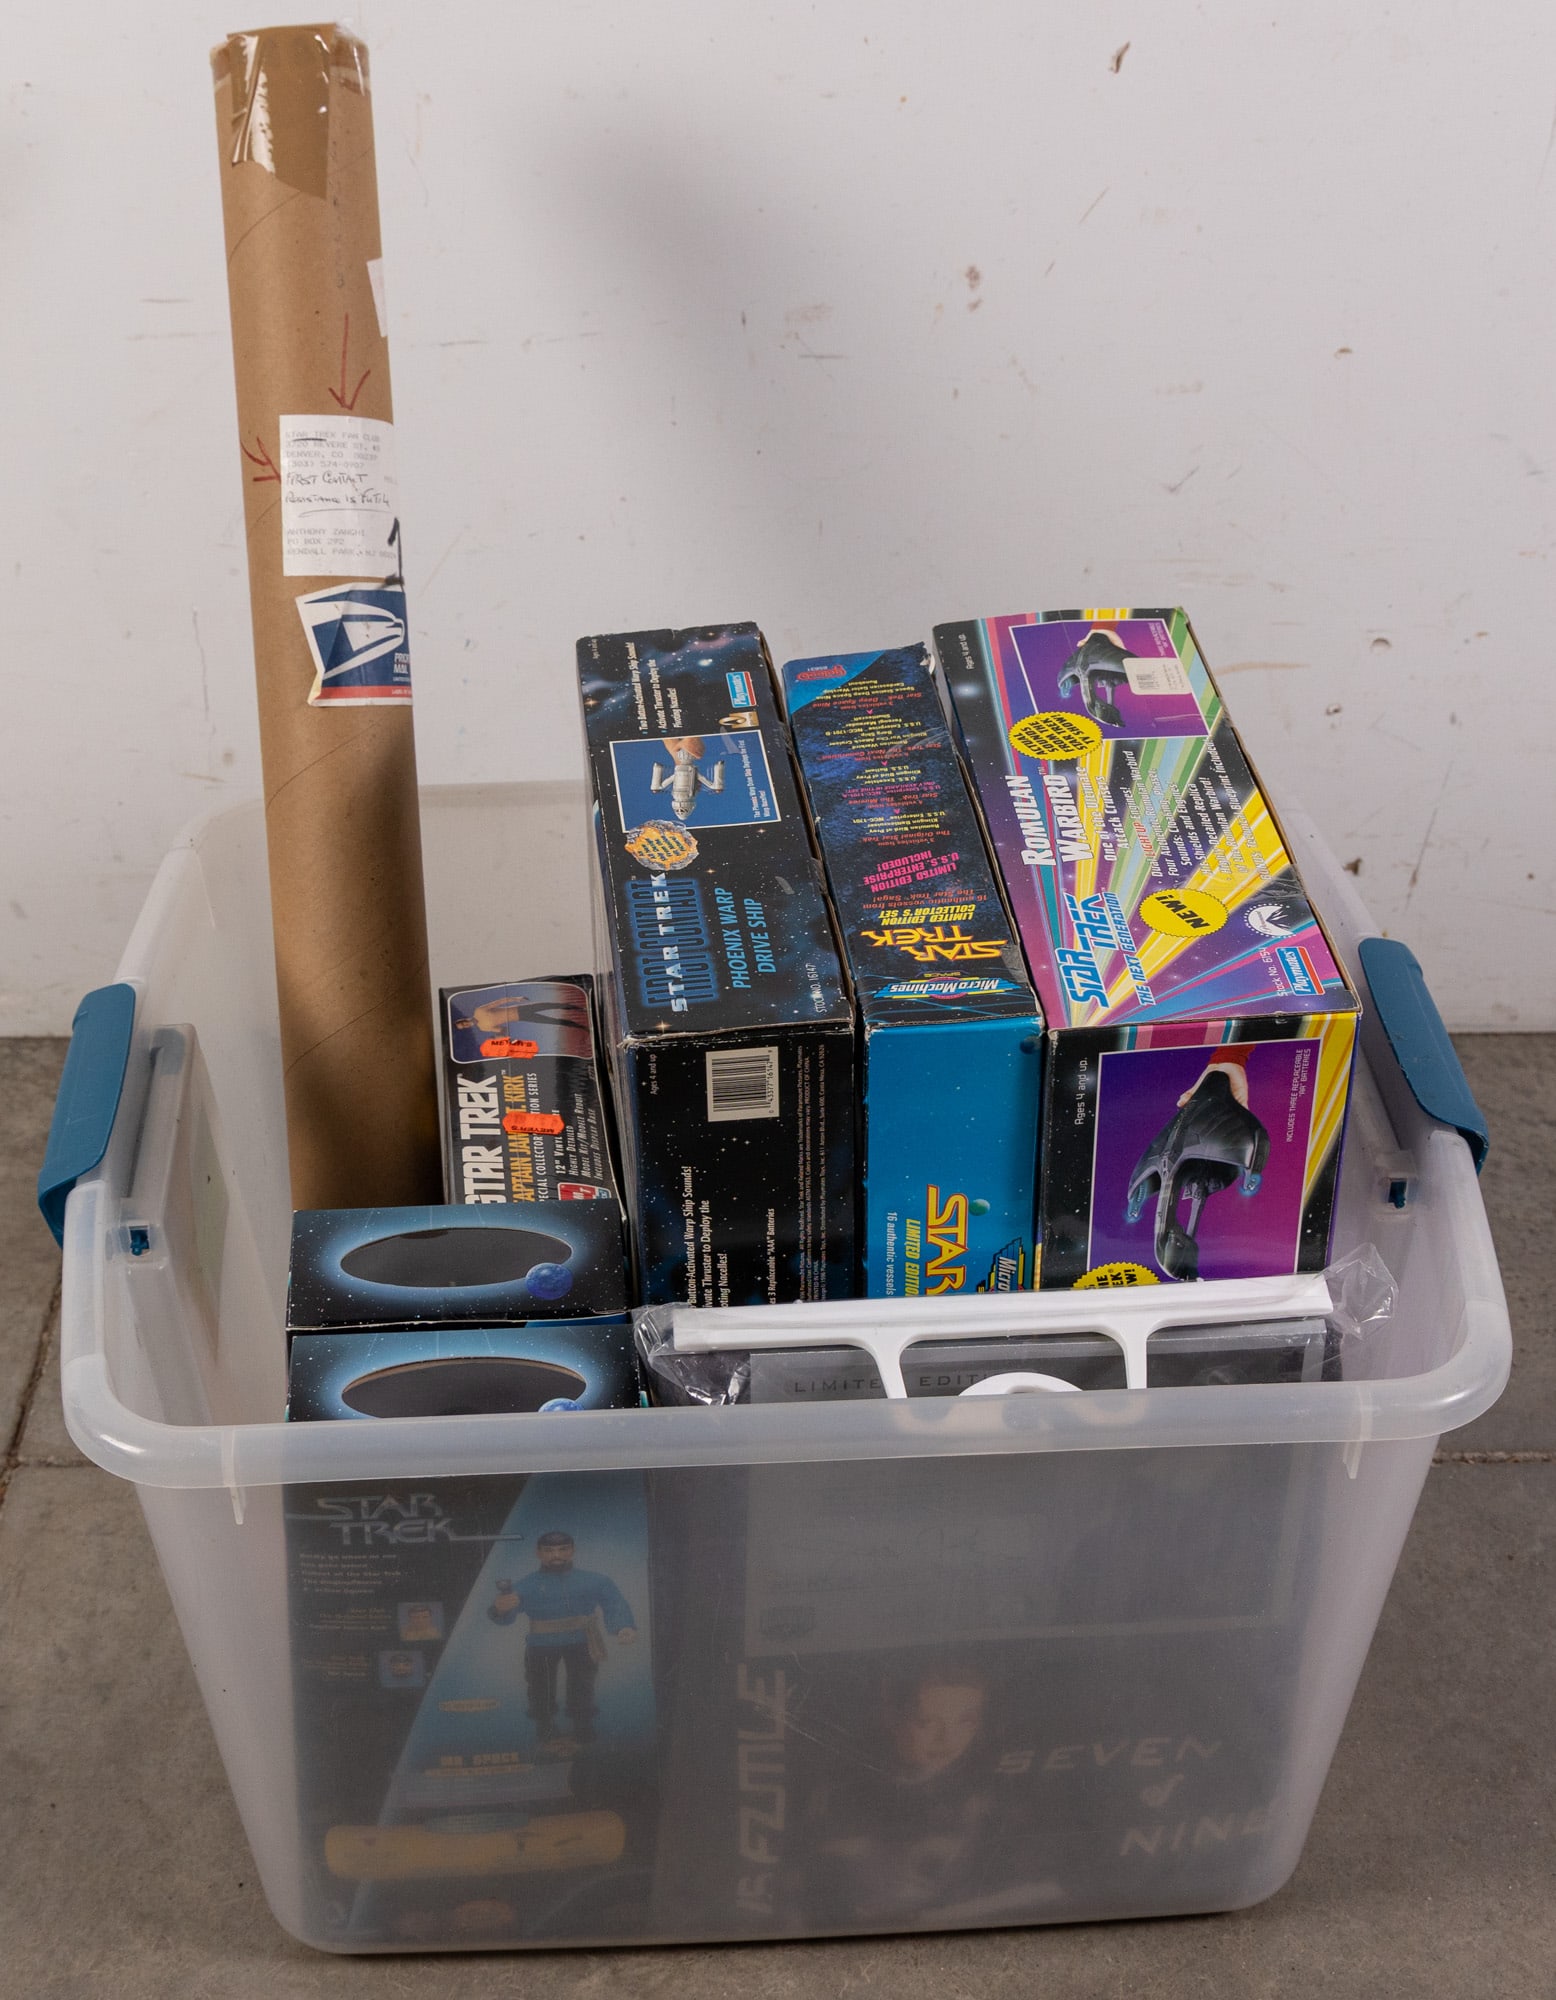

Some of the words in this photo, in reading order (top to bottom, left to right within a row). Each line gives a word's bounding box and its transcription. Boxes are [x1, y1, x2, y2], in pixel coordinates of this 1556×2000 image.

[624, 641, 637, 659] Sounds!
[627, 659, 640, 670] Ship
[646, 658, 656, 667] the
[629, 669, 643, 682] Warp
[647, 667, 661, 683] Deploy
[630, 682, 647, 719] Button-Activated
[650, 688, 664, 709] Thruster
[666, 687, 679, 708] Nacelles!
[728, 673, 749, 705] Playmates
[637, 720, 649, 730] Two
[654, 709, 668, 729] Activate
[669, 708, 685, 728] Pivoting
[1027, 720, 1048, 733] THE
[1040, 717, 1065, 734] TREK
[1049, 713, 1084, 735] SHOW!
[1012, 732, 1047, 755] ACTUAL
[1020, 726, 1059, 752] SOUNDS
[1045, 733, 1075, 752] FROM
[1061, 734, 1088, 750] STAR
[1078, 736, 1094, 744] TV
[1121, 749, 1143, 780] Warbird
[1202, 738, 1227, 774] Included!
[1073, 765, 1099, 808] Ultimate
[1092, 775, 1118, 814] Cruisers
[1186, 782, 1208, 811] Replica
[1198, 776, 1222, 809] Warbird!
[1217, 774, 1243, 810] Blueprint
[1119, 785, 1143, 819] Engines!
[1134, 782, 1156, 816] Romulan
[998, 773, 1056, 867] ROMULAN
[1035, 772, 1094, 862] WARBIRD
[1089, 810, 1106, 827] the
[1132, 821, 1146, 833] UP
[1179, 814, 1195, 830] and
[1197, 811, 1221, 845] Detailed
[1213, 811, 1237, 846] Romulan
[1094, 829, 1110, 839] of
[1106, 816, 1130, 849] Attack
[1147, 818, 1172, 856] Authentic
[1099, 841, 1118, 861] One
[1136, 833, 1156, 856] LIGHT
[1170, 834, 1193, 866] Sounds:
[1185, 830, 1207, 860] Shields
[1228, 848, 1244, 863] the
[875, 849, 932, 871] INCLUDED!
[926, 851, 959, 867] U.S.S.
[1145, 856, 1164, 877] Dual
[1162, 856, 1180, 876] Four
[1197, 861, 1213, 874] Hit
[1211, 847, 1233, 874] Highly
[862, 861, 925, 885] ENTERPRISE
[914, 862, 956, 880] LIMITED
[869, 874, 912, 892] EDITION
[649, 872, 676, 935] TREK
[713, 886, 738, 924] WARP
[871, 893, 902, 902] Saga!
[926, 895, 974, 904] authentic
[742, 896, 767, 929] SHIP
[876, 909, 900, 918] SET
[878, 915, 926, 925] EDITION
[900, 903, 977, 916] COLLECTOR'S
[927, 911, 975, 922] LIMITED
[1101, 890, 1136, 952] GENERATION
[1153, 892, 1211, 929] NEW!
[1063, 891, 1119, 952] TREK
[858, 924, 974, 947] TREK
[721, 927, 752, 989] PHOENIX
[749, 930, 776, 973] DRIVE
[897, 940, 1013, 963] STAR
[661, 945, 689, 1012] STAR
[1053, 945, 1110, 1009] STAR
[1123, 953, 1147, 981] NEXT
[1265, 964, 1279, 975] No.
[1278, 950, 1314, 992] Playmates
[887, 981, 959, 995] Machines
[955, 979, 1001, 991] Micro
[1133, 982, 1155, 1004] THE
[1269, 977, 1288, 996] Stock
[648, 1053, 658, 1062] up
[648, 1063, 657, 1074] and
[1076, 1056, 1088, 1072] up.
[1299, 1047, 1312, 1082] BATTERIES
[1290, 1048, 1304, 1091] REPLACEABLE
[502, 1074, 526, 1102] KIRK
[526, 1072, 538, 1095] SERIES
[649, 1080, 658, 1095] Ages
[1075, 1073, 1087, 1091] and
[456, 1073, 501, 1140] TREK
[1074, 1100, 1086, 1125] Ages
[1288, 1091, 1299, 1111] THREE
[587, 1107, 597, 1122] BASE
[563, 1124, 576, 1152] DETAILED
[1285, 1112, 1297, 1142] INCLUDES
[506, 1129, 531, 1155] JAM
[532, 1133, 546, 1176] COLLECTOR'
[567, 1154, 579, 1176] HIGHLY
[580, 1154, 592, 1177] MODEL
[590, 1150, 604, 1180] INCLUDES
[509, 1155, 535, 1203] APTAIN
[680, 1165, 693, 1197] Sounds!
[682, 1198, 695, 1217] Ship
[699, 1199, 710, 1213] the
[885, 1211, 897, 1221] 16
[683, 1217, 696, 1240] Warp
[699, 1214, 712, 1242] Deploy
[765, 1208, 775, 1235] Batteries
[701, 1243, 711, 1252] to
[766, 1235, 775, 1255] "AAA"
[885, 1222, 897, 1262] authentic
[905, 1217, 921, 1259] LIMITED
[925, 1181, 968, 1294] STAR
[684, 1240, 697, 1303] Button-Activated
[701, 1253, 712, 1286] Thruster
[716, 1252, 728, 1286] Nacelles!
[766, 1255, 776, 1290] Replaceable
[885, 1263, 895, 1295] vessels
[997, 1255, 1016, 1291] Micro
[794, 1378, 881, 1393] LIMITE
[285, 1493, 444, 1521] STAR
[328, 1517, 481, 1545] TREK
[994, 1735, 1223, 1774] SEVEN
